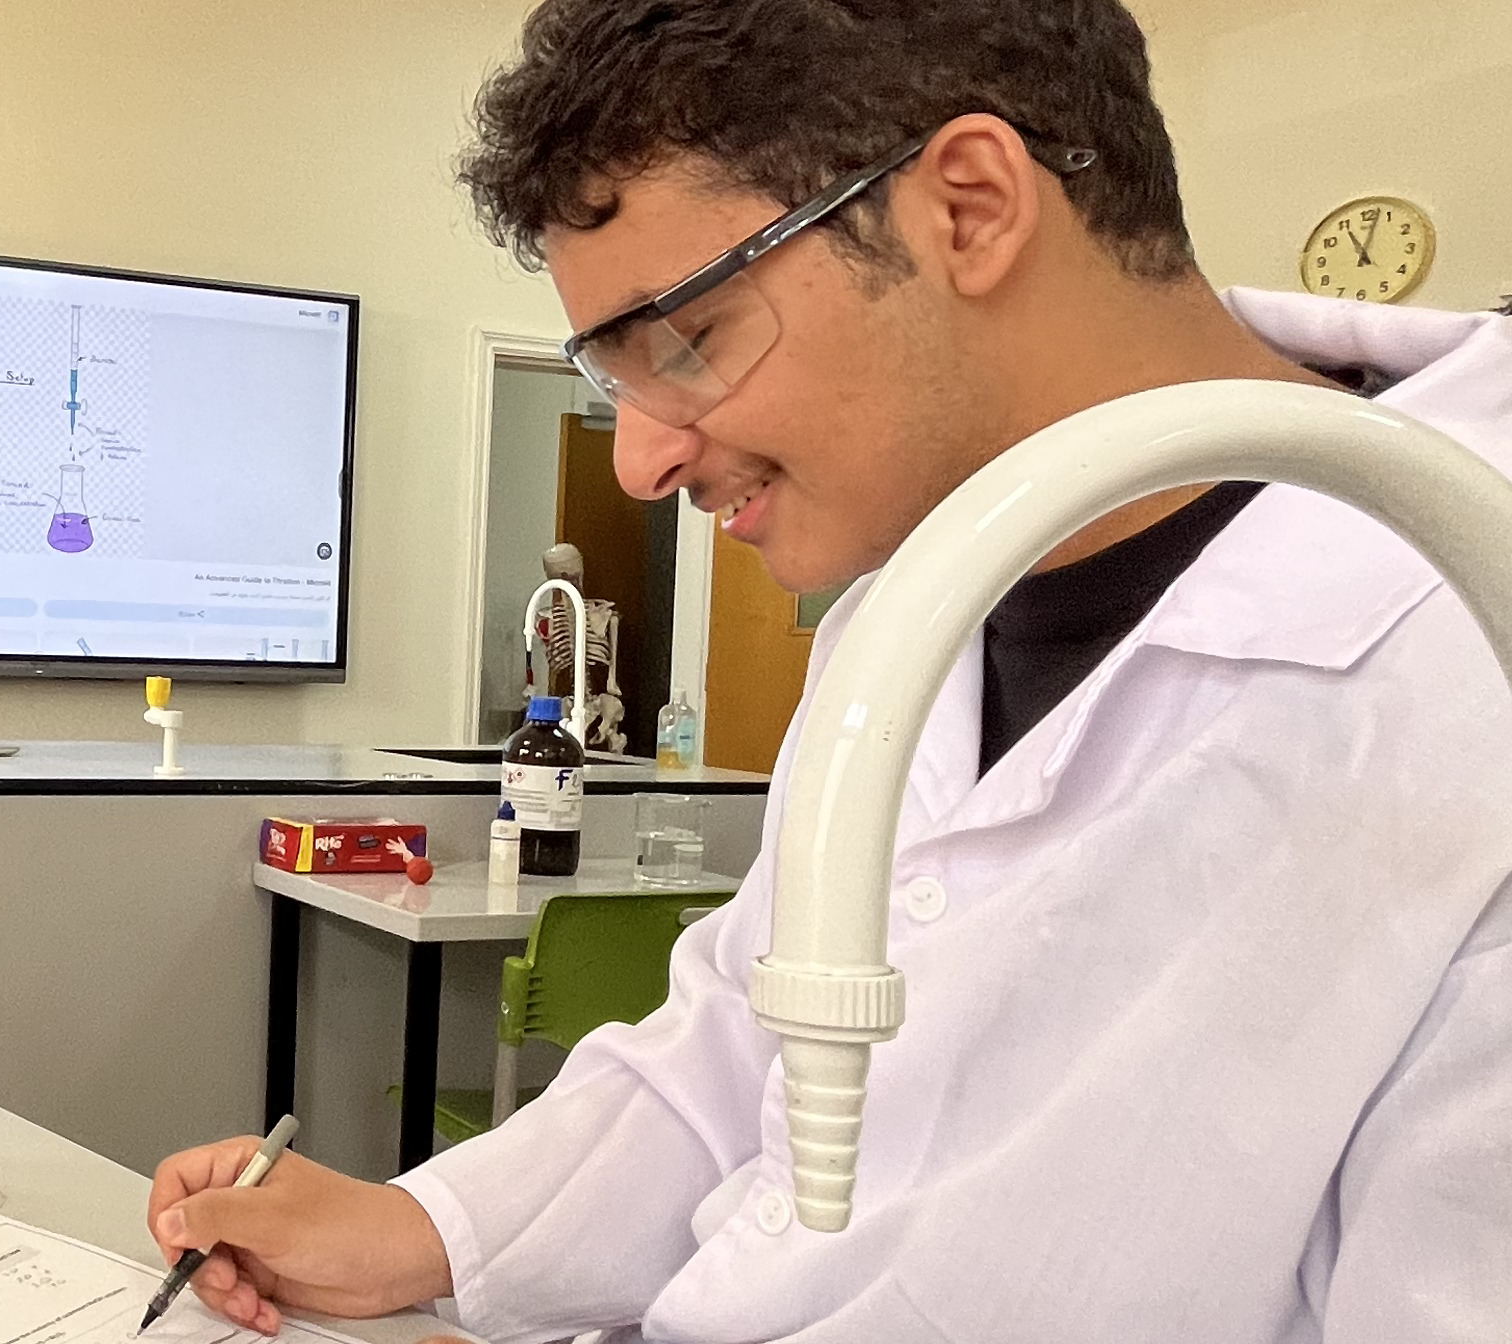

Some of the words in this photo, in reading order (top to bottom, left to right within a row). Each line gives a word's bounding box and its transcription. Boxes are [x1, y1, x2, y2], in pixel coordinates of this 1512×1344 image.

[1360, 209, 1378, 222] 12
[1387, 212, 1392, 222] 1
[1339, 219, 1350, 231] 11
[1400, 224, 1410, 235] 2
[1324, 237, 1337, 249] 10
[1404, 243, 1416, 254] 3
[1317, 257, 1326, 268] 9
[1396, 264, 1407, 275] 4
[1321, 275, 1330, 286] 8
[1379, 281, 1389, 293] 5
[1336, 288, 1345, 298] 7
[1356, 290, 1366, 301] 6
